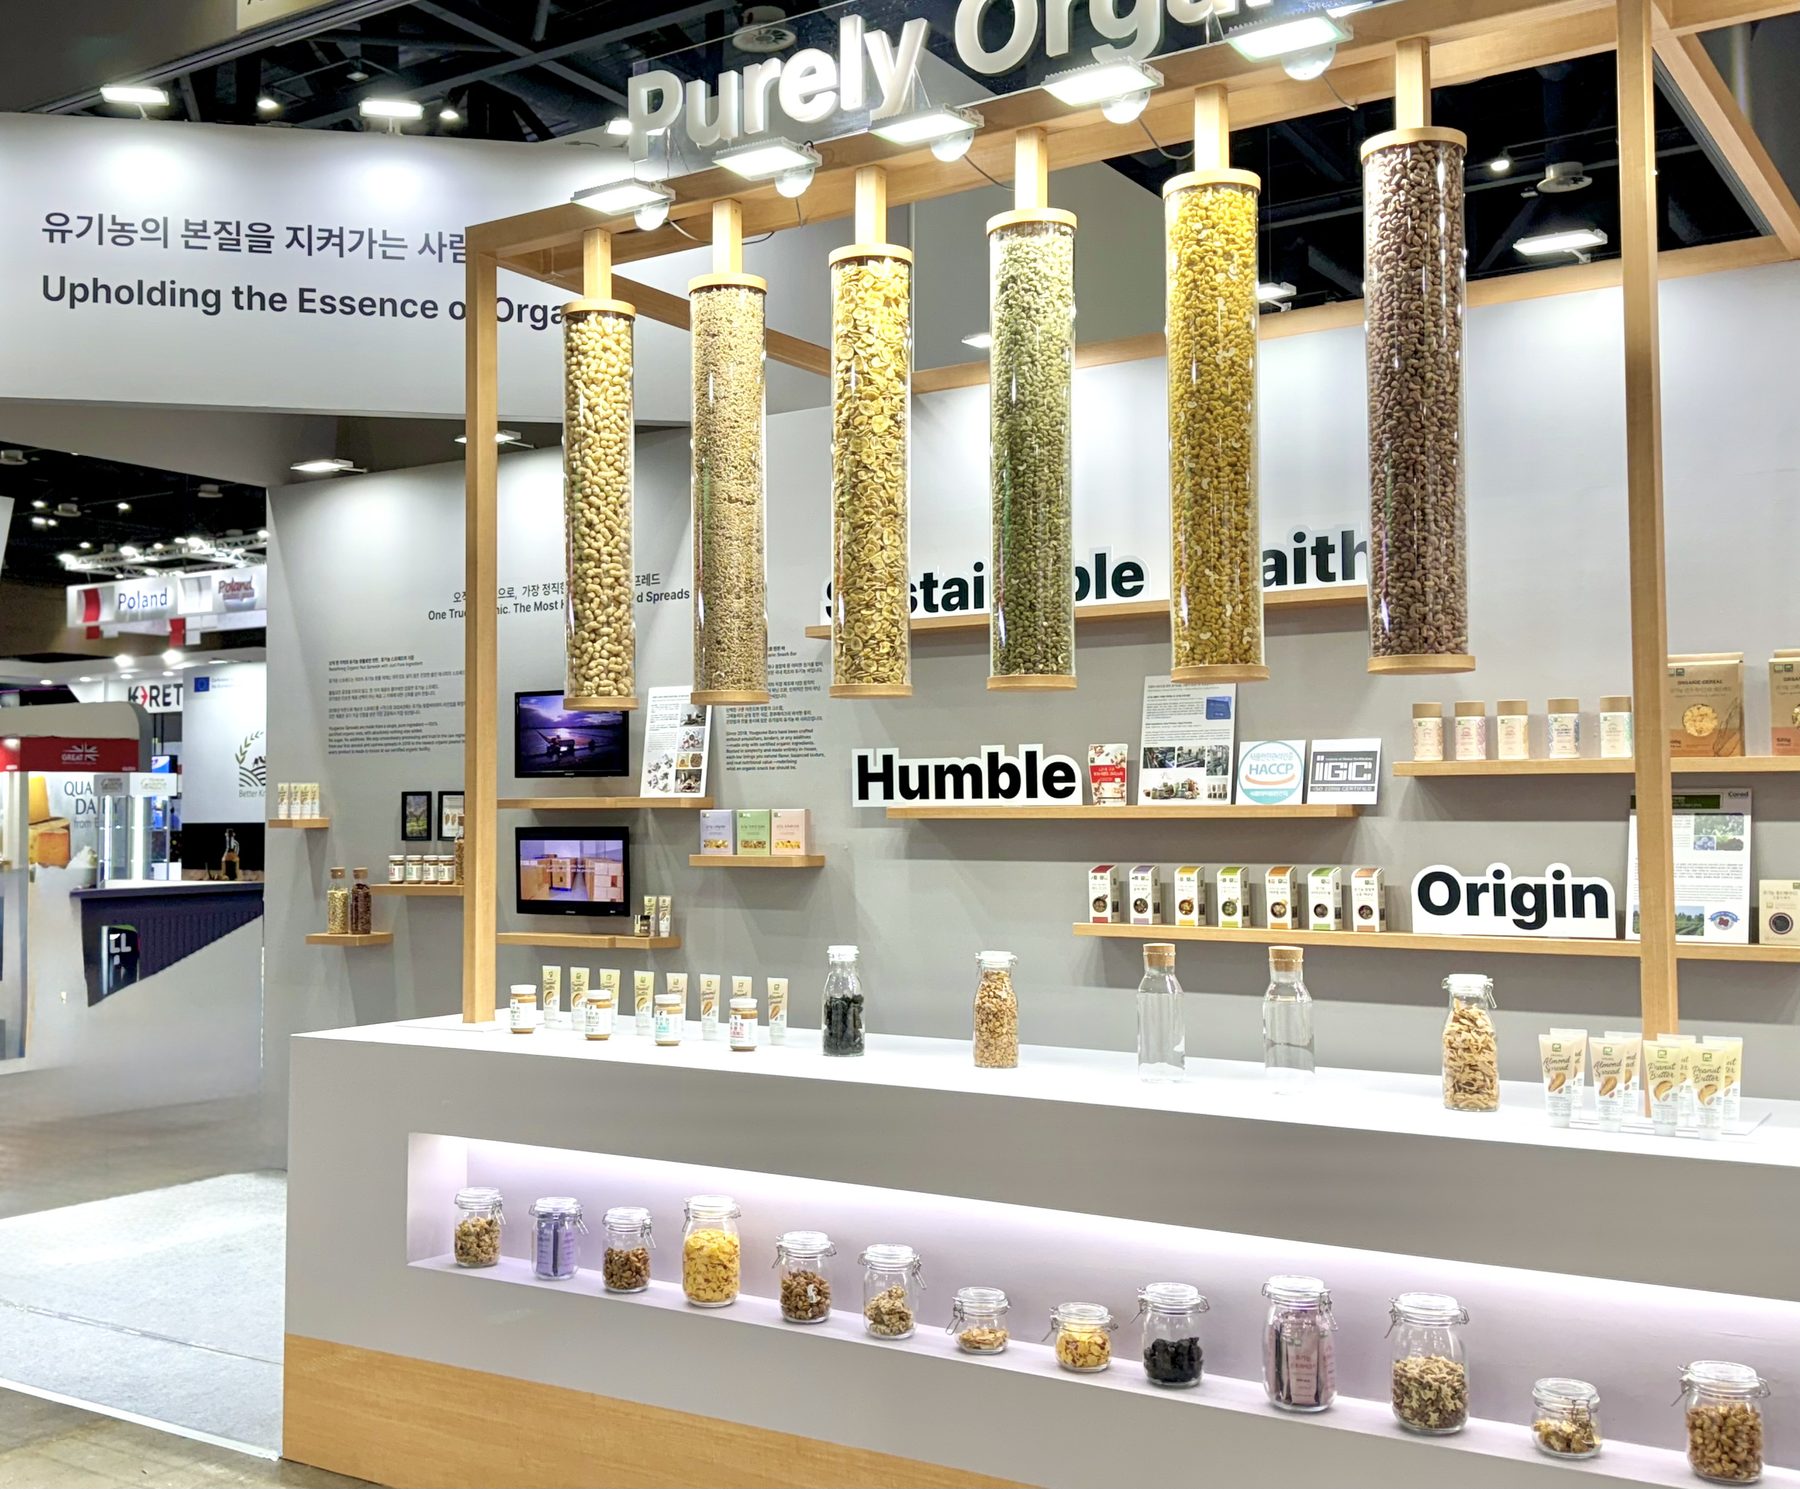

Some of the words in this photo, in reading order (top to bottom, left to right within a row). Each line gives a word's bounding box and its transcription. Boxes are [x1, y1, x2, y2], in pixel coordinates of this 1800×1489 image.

[627, 14, 930, 162] Purely
[41, 212, 169, 249] 유기농의
[180, 219, 275, 255] 본질을
[284, 224, 408, 261] 지켜가는
[42, 275, 222, 316] Upholding
[231, 285, 288, 312] the
[298, 287, 439, 318] Essence
[448, 300, 466, 320] o
[496, 297, 562, 331] Orga
[1263, 530, 1368, 587] aith
[219, 576, 253, 594] Poland
[453, 591, 466, 603] 오
[497, 586, 518, 600] 으로,
[522, 584, 540, 598] 가장
[118, 588, 168, 611] Poland
[428, 610, 447, 621] One
[513, 602, 531, 613] The
[533, 600, 559, 612] Most
[645, 588, 690, 604] Spreads
[61, 753, 84, 762] GREAT
[857, 750, 1076, 801] Humble
[1248, 762, 1295, 776] HACCP
[63, 780, 94, 797] QUA
[238, 789, 258, 798] Better
[1417, 868, 1609, 931] Origin
[1543, 1055, 1571, 1066] Almond
[1593, 1059, 1623, 1069] Almond
[1648, 1062, 1677, 1071] Peanut
[1649, 1070, 1675, 1081] Butter
[1692, 1065, 1722, 1075] Peanut
[1694, 1073, 1720, 1084] Butter
